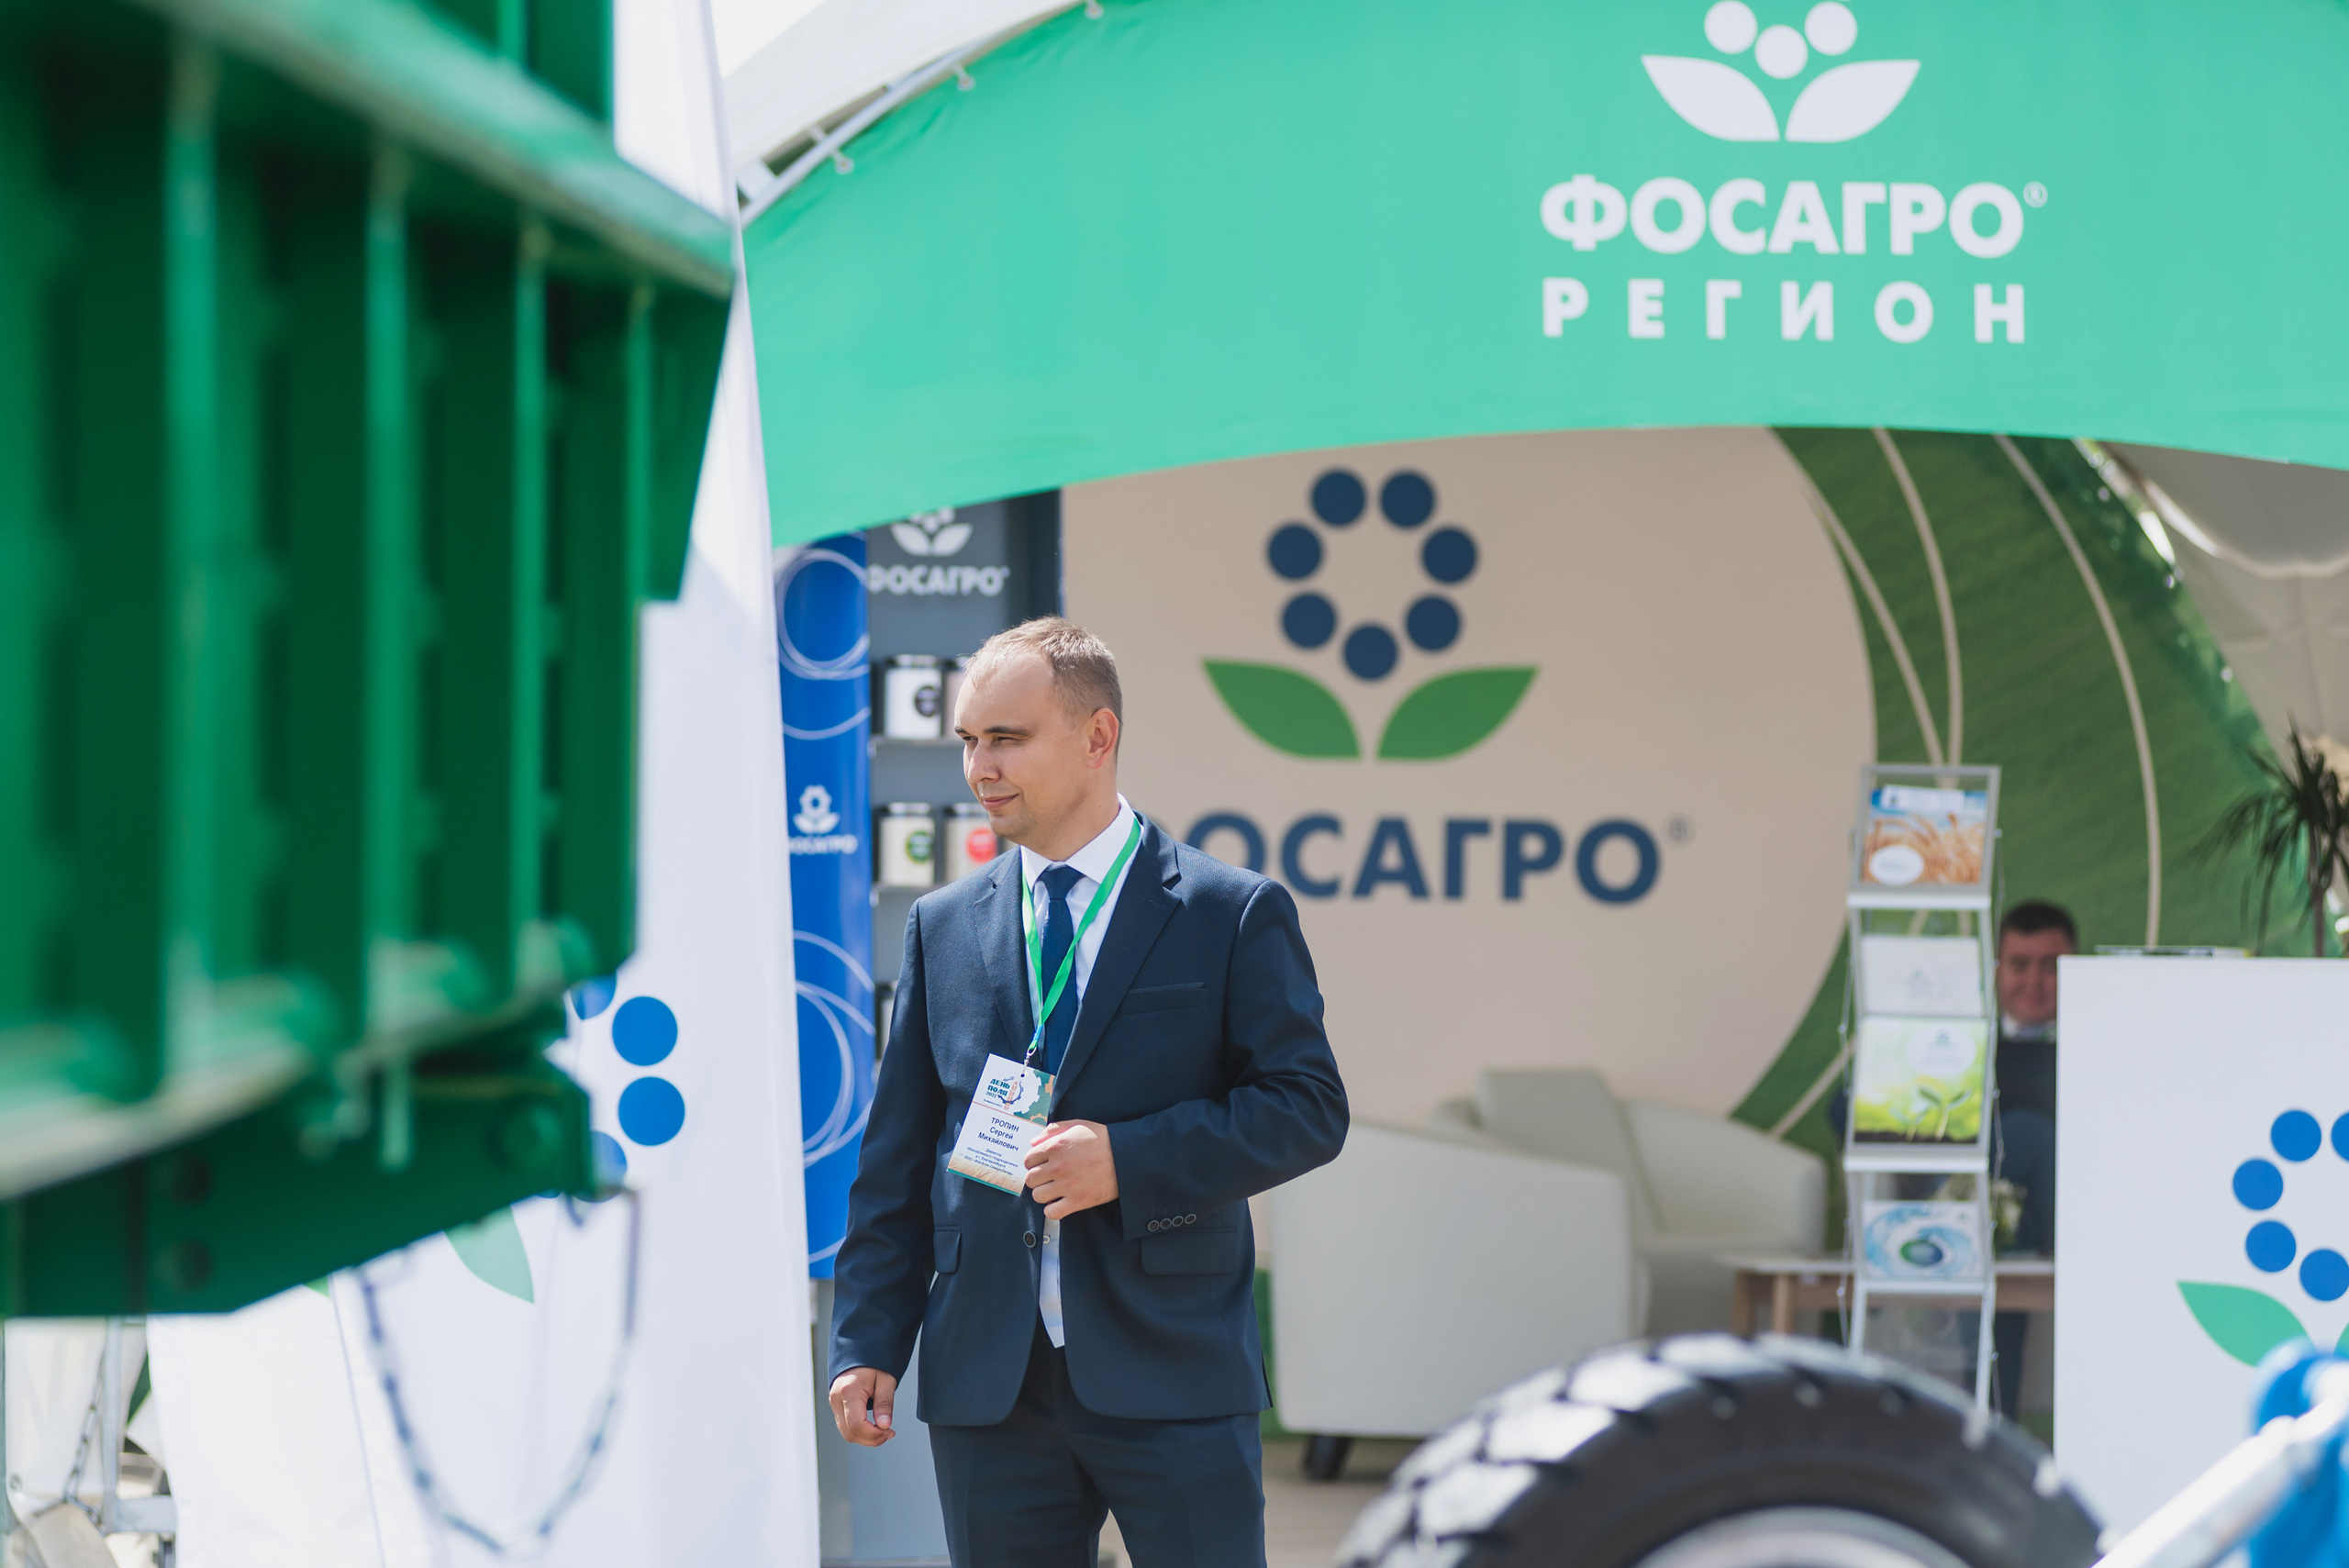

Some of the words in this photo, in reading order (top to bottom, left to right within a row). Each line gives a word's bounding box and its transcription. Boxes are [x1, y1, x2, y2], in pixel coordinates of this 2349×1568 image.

[1542, 276, 2025, 344] РЕГИОН
[1152, 811, 1661, 906] ОСАГРО
[987, 1084, 1008, 1096] ПОЛЯ
[989, 1078, 1010, 1090] ДЕНЬ
[991, 1117, 1019, 1132] ТРОПИН
[977, 1131, 1019, 1151] Михайлович
[989, 1127, 1014, 1140] Сергей
